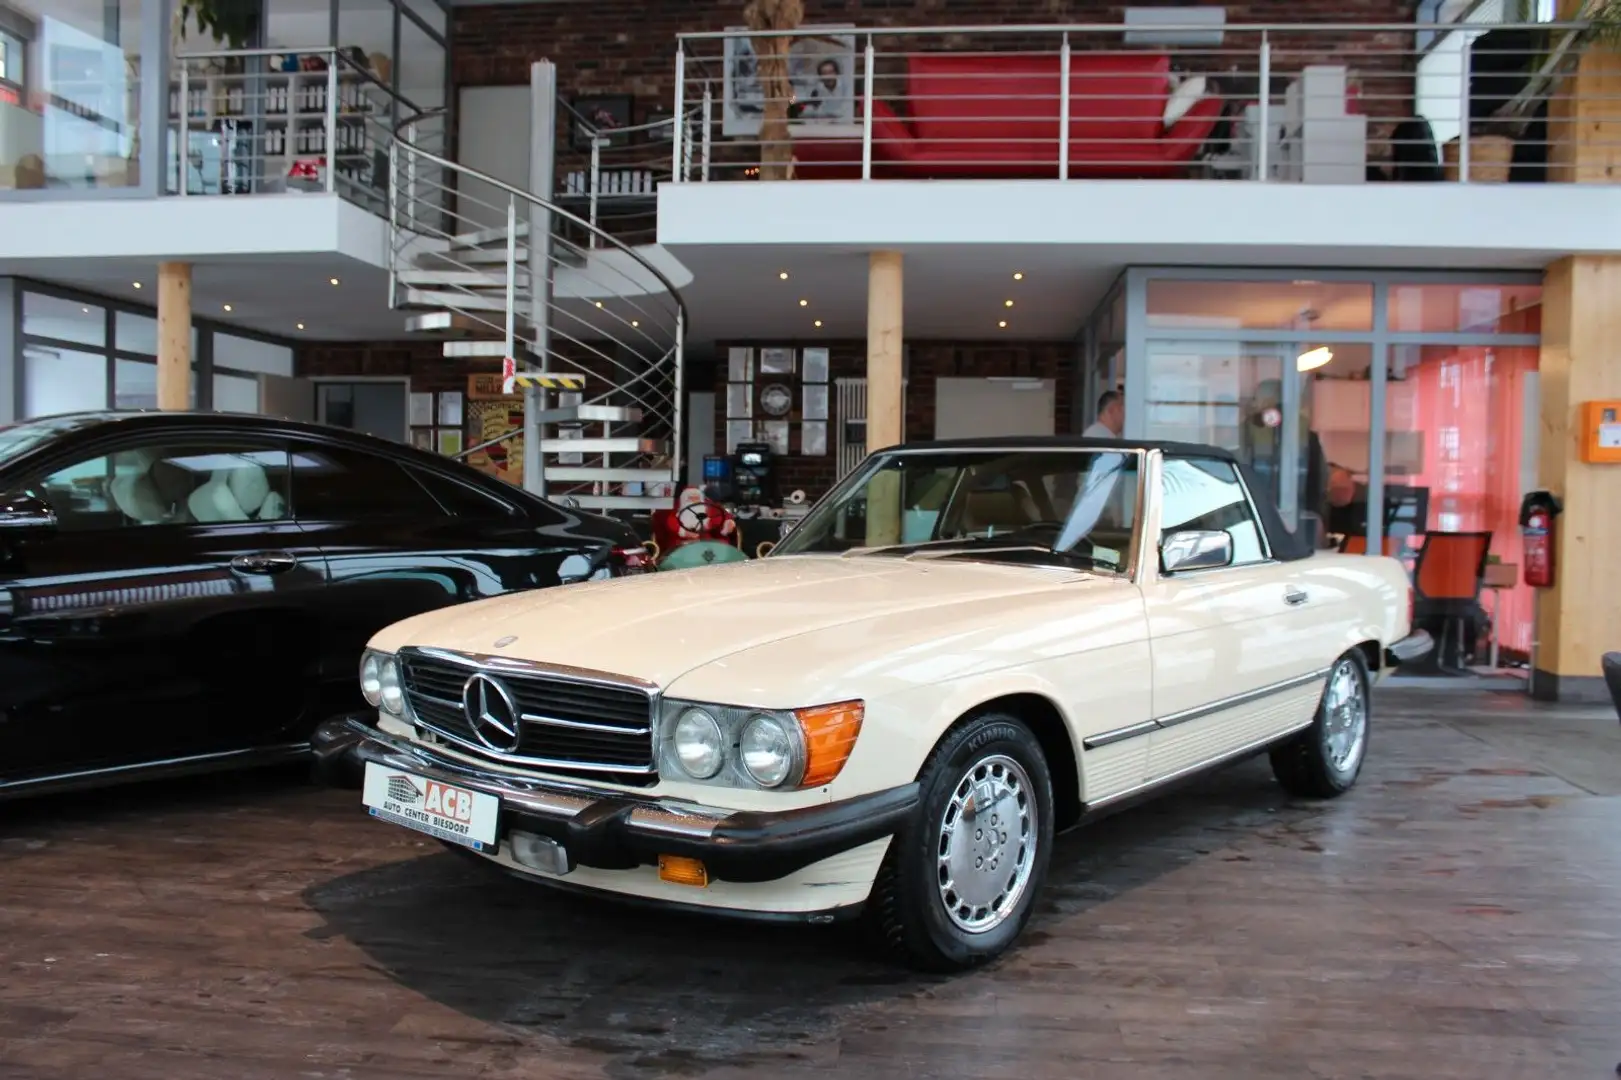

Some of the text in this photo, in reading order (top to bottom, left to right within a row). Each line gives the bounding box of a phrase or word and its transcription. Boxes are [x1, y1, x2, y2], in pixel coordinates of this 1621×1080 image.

[968, 727, 1016, 752] KUMHO
[384, 801, 401, 813] AUTO
[404, 808, 430, 823] CENTER
[433, 816, 470, 835] BIESDORF
[425, 783, 471, 821] ACB
